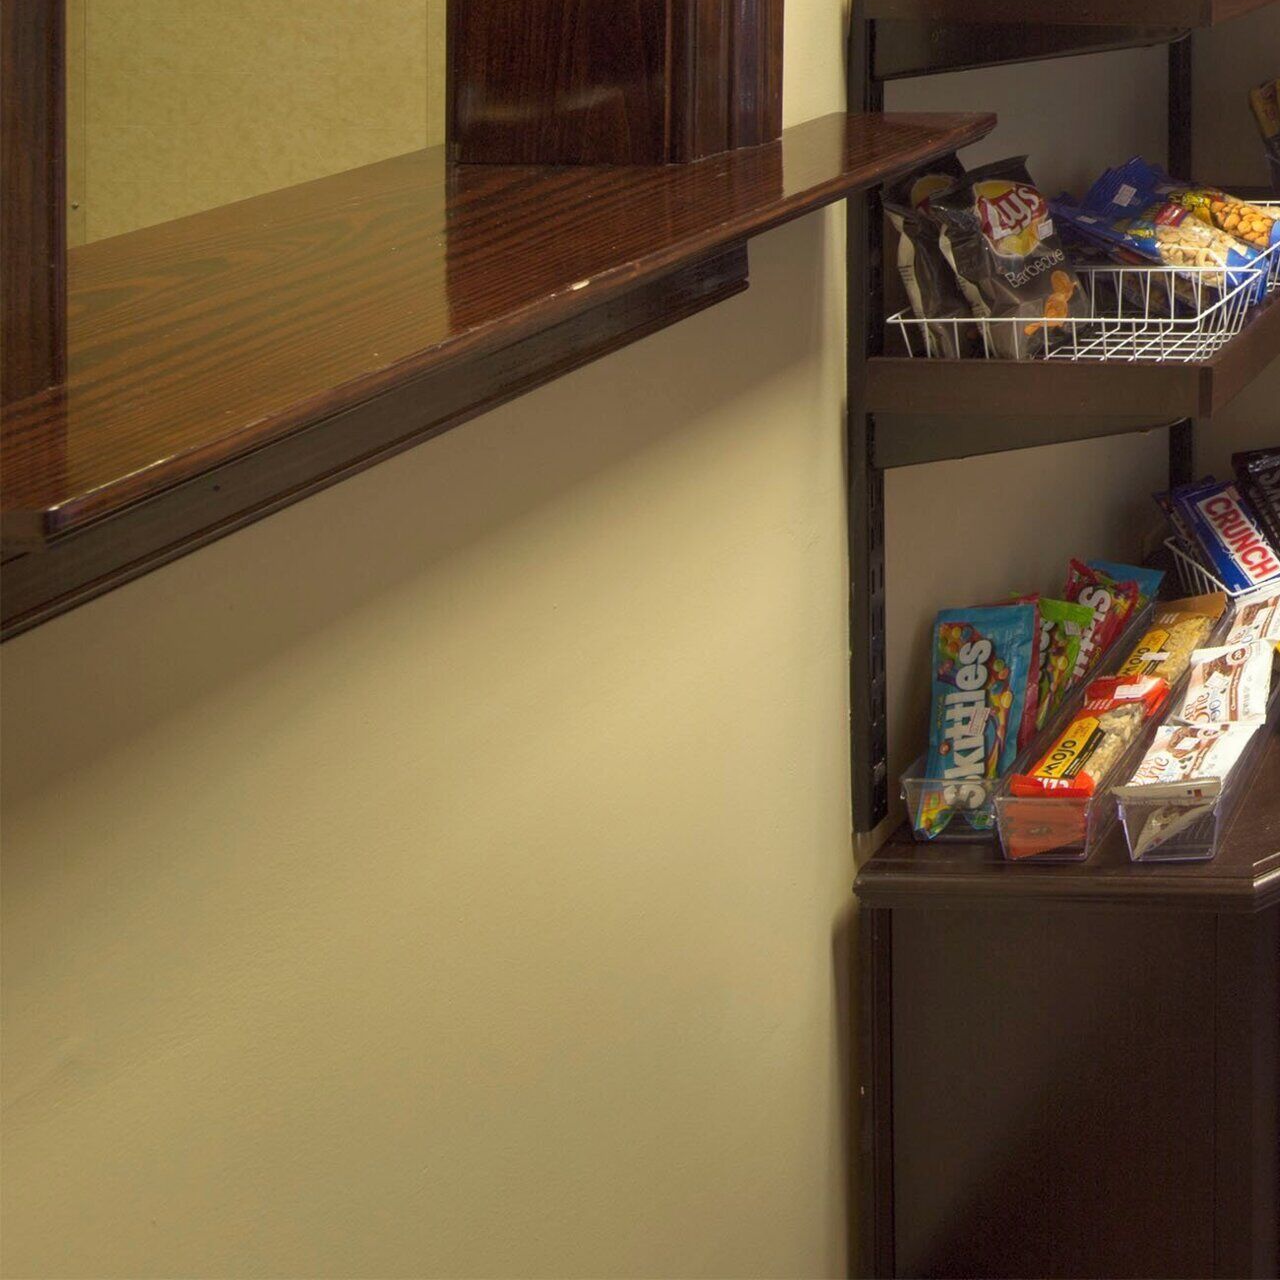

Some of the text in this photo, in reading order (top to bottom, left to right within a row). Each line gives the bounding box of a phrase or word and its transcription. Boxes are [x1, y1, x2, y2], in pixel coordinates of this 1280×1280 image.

[984, 187, 1041, 240] Lay's
[1004, 248, 1065, 288] Barbecue
[1203, 496, 1280, 580] CRUNCH
